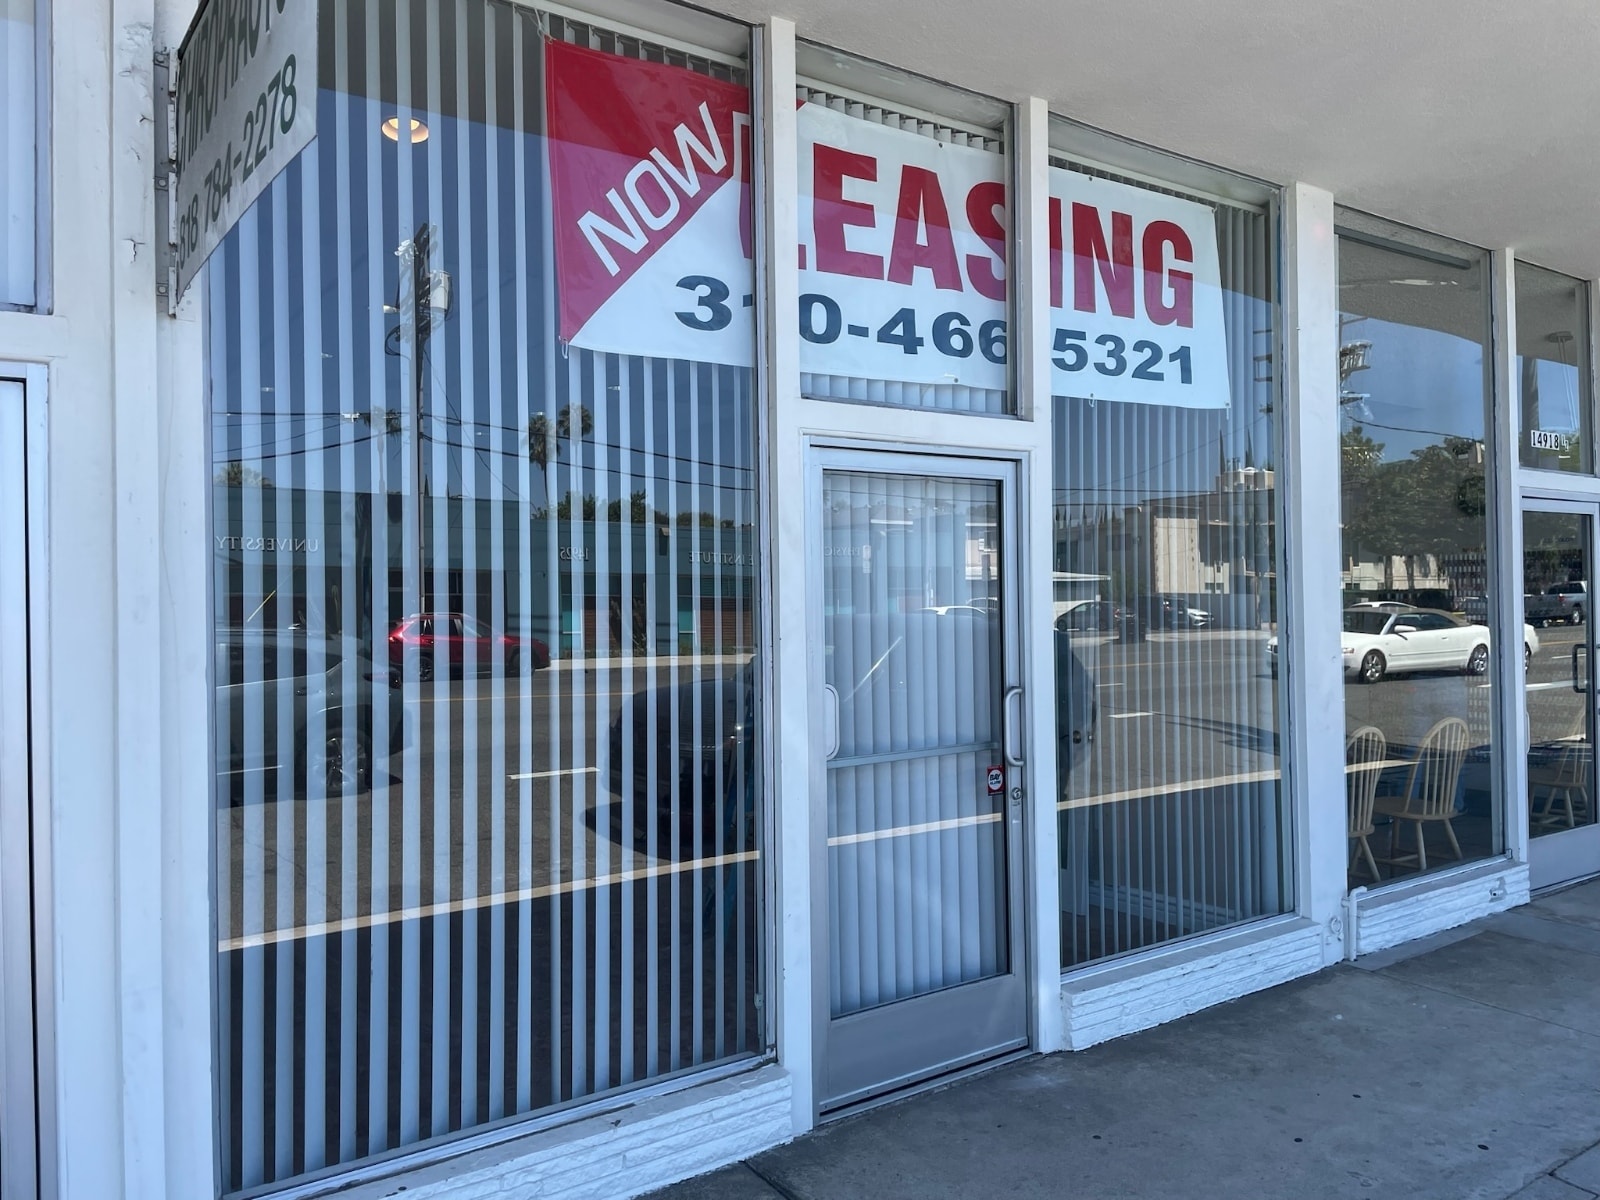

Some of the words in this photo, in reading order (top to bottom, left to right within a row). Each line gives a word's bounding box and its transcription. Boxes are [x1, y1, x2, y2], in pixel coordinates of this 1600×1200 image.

[180, 193, 198, 270] 818
[204, 53, 297, 233] 784-2278
[577, 101, 727, 277] NOW
[674, 274, 1193, 385] 30-4665321
[1532, 431, 1559, 449] 14918
